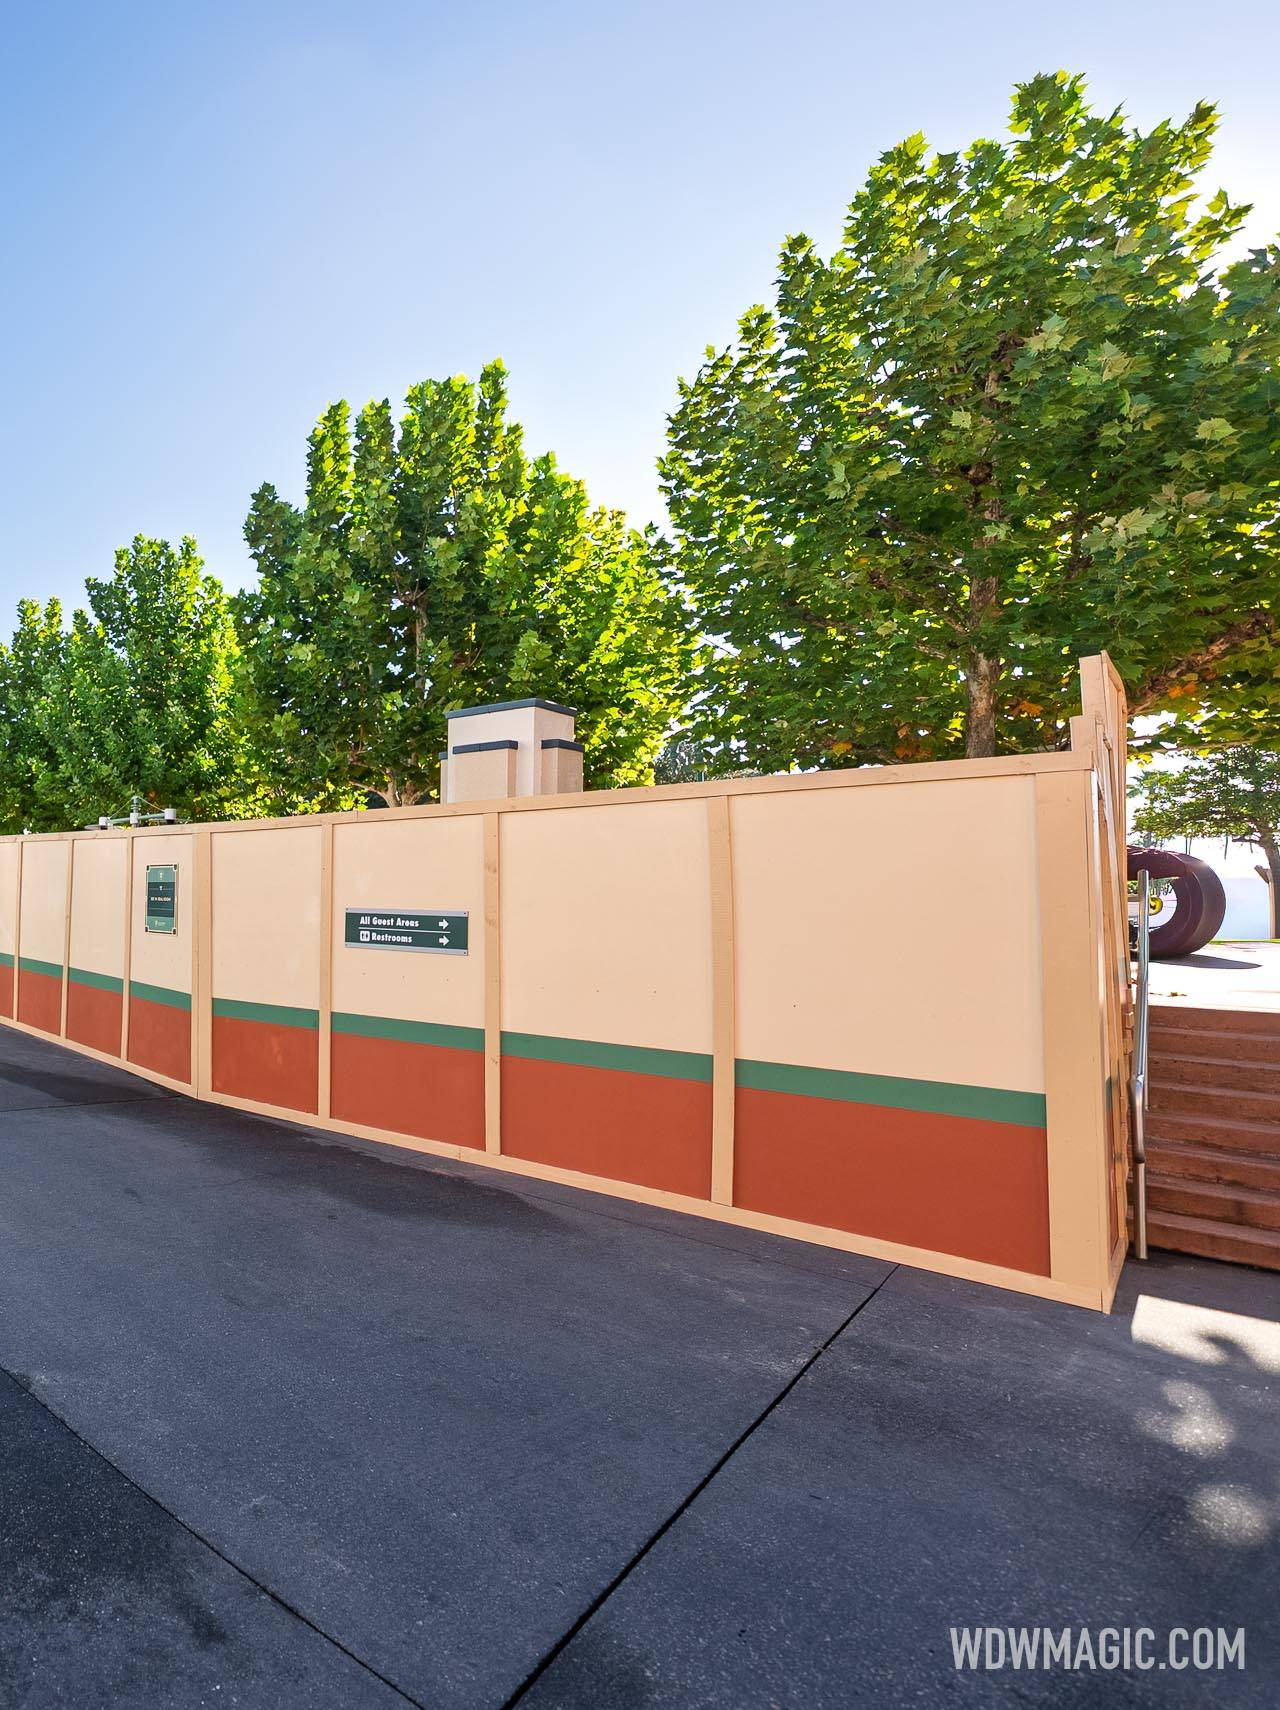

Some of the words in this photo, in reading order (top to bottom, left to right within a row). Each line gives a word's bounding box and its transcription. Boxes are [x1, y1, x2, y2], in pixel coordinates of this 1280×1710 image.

[360, 916, 370, 925] All
[372, 917, 394, 926] Guest
[396, 918, 419, 927] Areas
[371, 932, 412, 943] Restrooms
